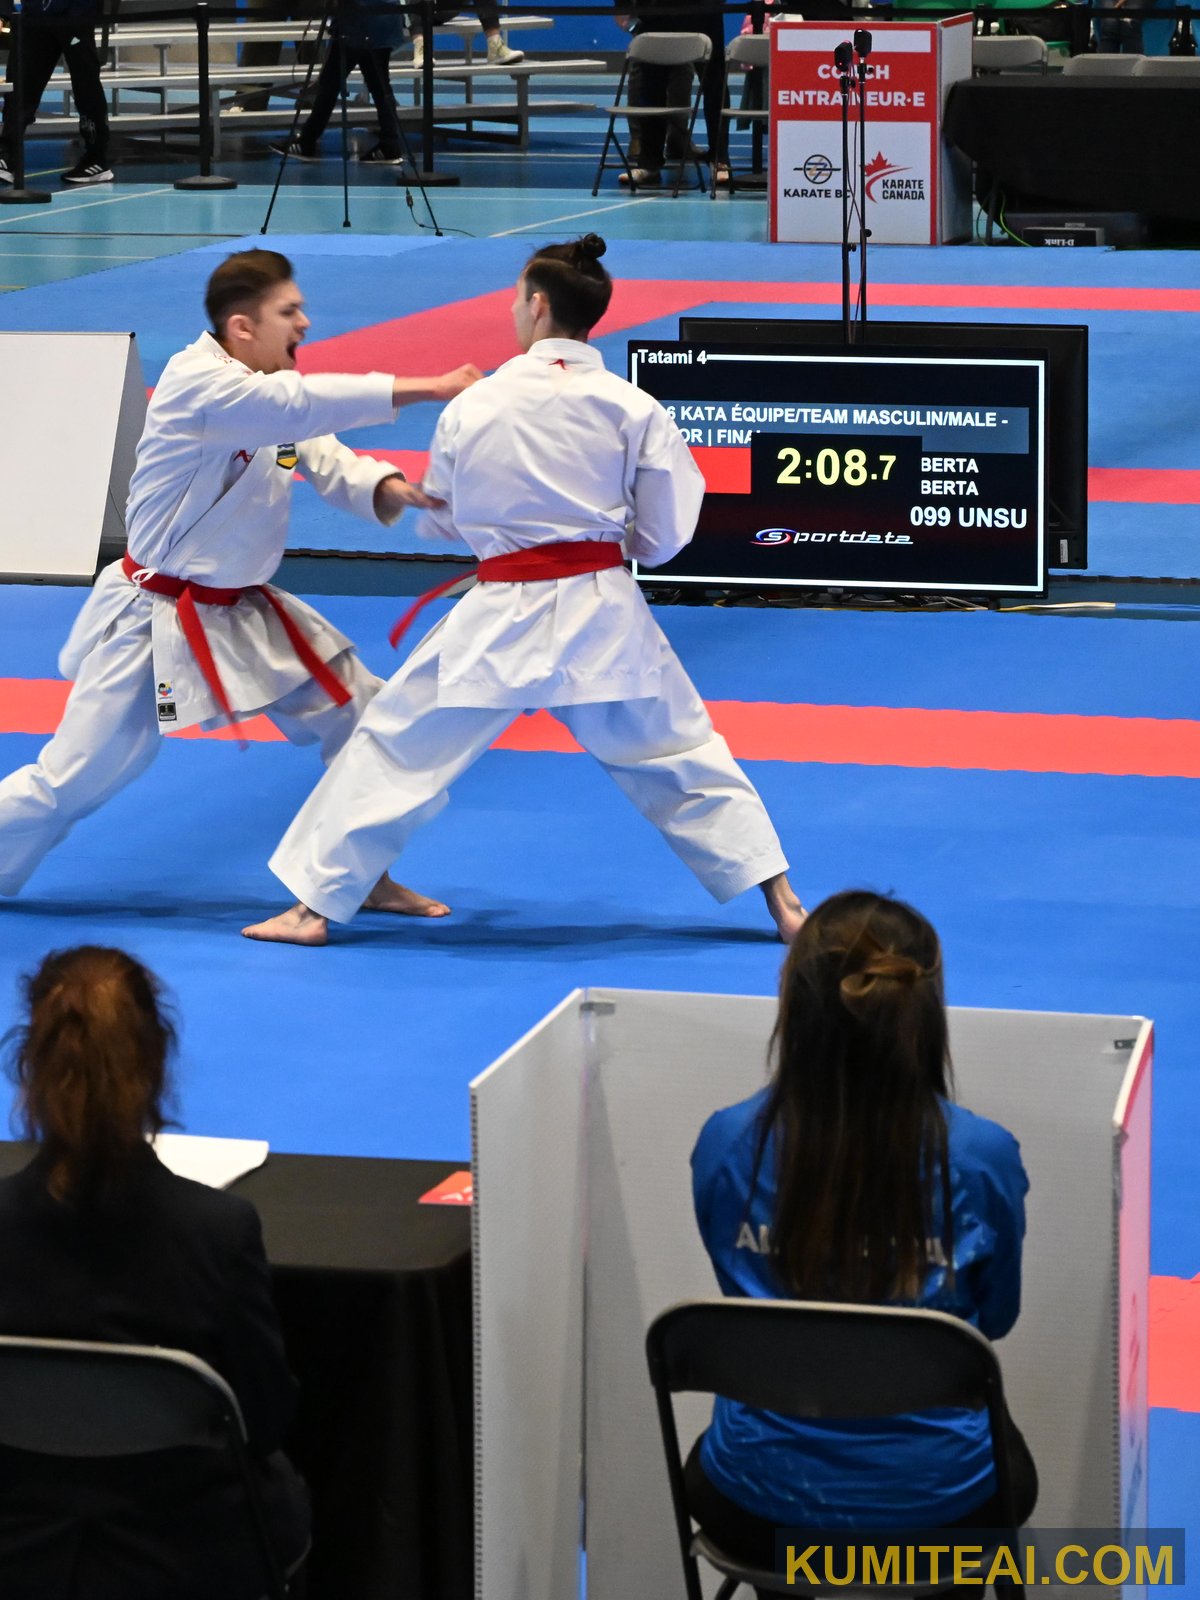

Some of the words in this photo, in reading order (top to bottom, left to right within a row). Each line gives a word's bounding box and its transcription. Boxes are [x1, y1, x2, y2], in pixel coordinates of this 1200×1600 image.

[882, 180, 924, 190] KARATE
[783, 188, 832, 199] KARATE
[882, 190, 925, 200] CANADA
[637, 349, 693, 365] Tatami
[696, 350, 708, 365] 4
[681, 406, 727, 422] KATA
[731, 403, 848, 424] ÉQUIPE/TEAM
[853, 409, 997, 427] MASCULIN/MALE
[717, 429, 761, 444] FINA
[776, 447, 897, 486] 2:08.7
[921, 457, 980, 473] BERTA
[921, 480, 980, 496] BERTA
[910, 506, 951, 527] 099
[958, 507, 1028, 529] UNSU
